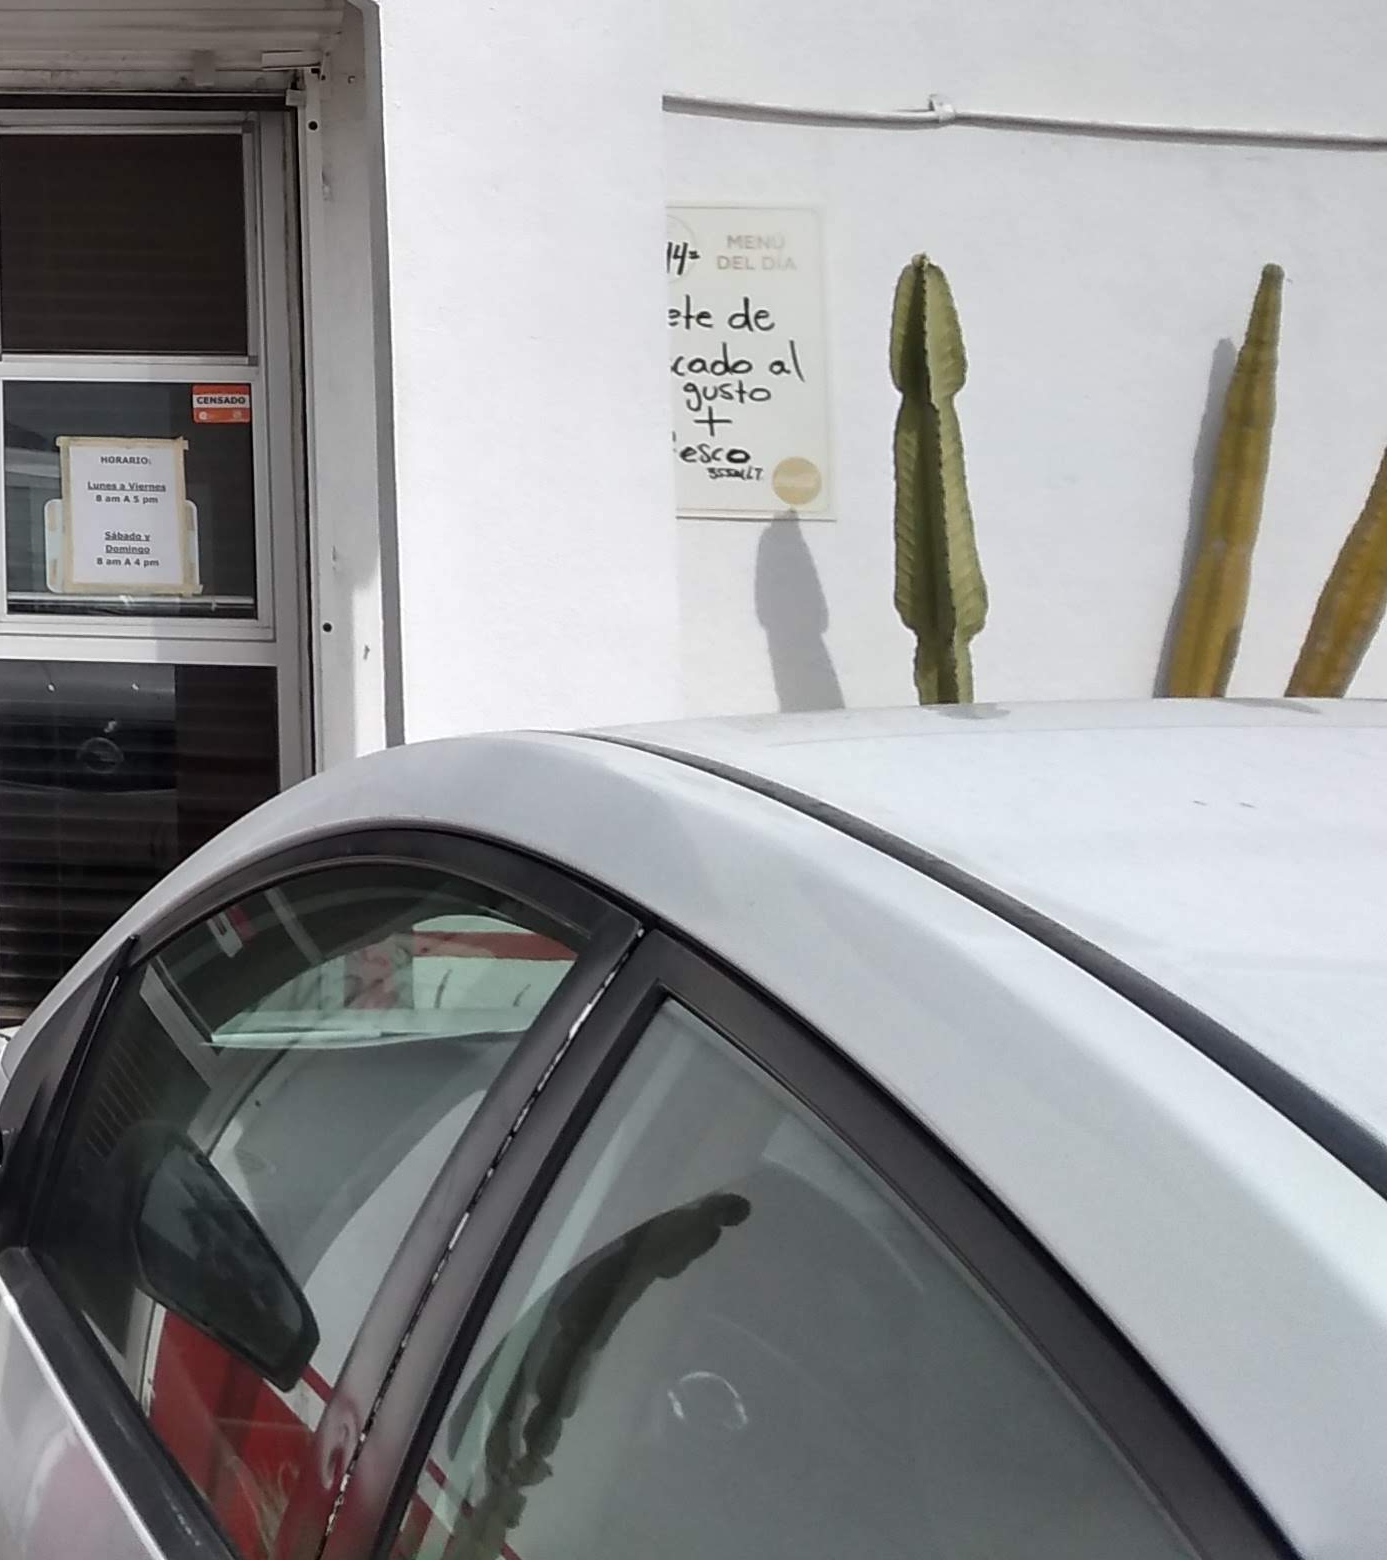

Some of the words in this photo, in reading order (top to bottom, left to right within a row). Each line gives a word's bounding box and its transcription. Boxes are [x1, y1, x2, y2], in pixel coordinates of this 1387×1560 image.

[716, 255, 756, 271] DEL
[728, 296, 775, 332] de
[671, 342, 753, 376] cado
[768, 340, 804, 382] al
[196, 396, 246, 405] CENSADO
[683, 380, 771, 411] gusto
[673, 440, 750, 463] esco
[87, 481, 117, 491] Lunes
[128, 482, 166, 492] Viernes
[105, 495, 121, 503] am
[123, 495, 131, 503] A
[133, 495, 140, 503] 5
[142, 496, 159, 504] pm
[105, 544, 151, 554] Domingo
[96, 557, 103, 565] 8
[106, 558, 122, 566] am
[124, 558, 131, 566] A
[134, 558, 141, 566] 4
[143, 559, 160, 568] pm
